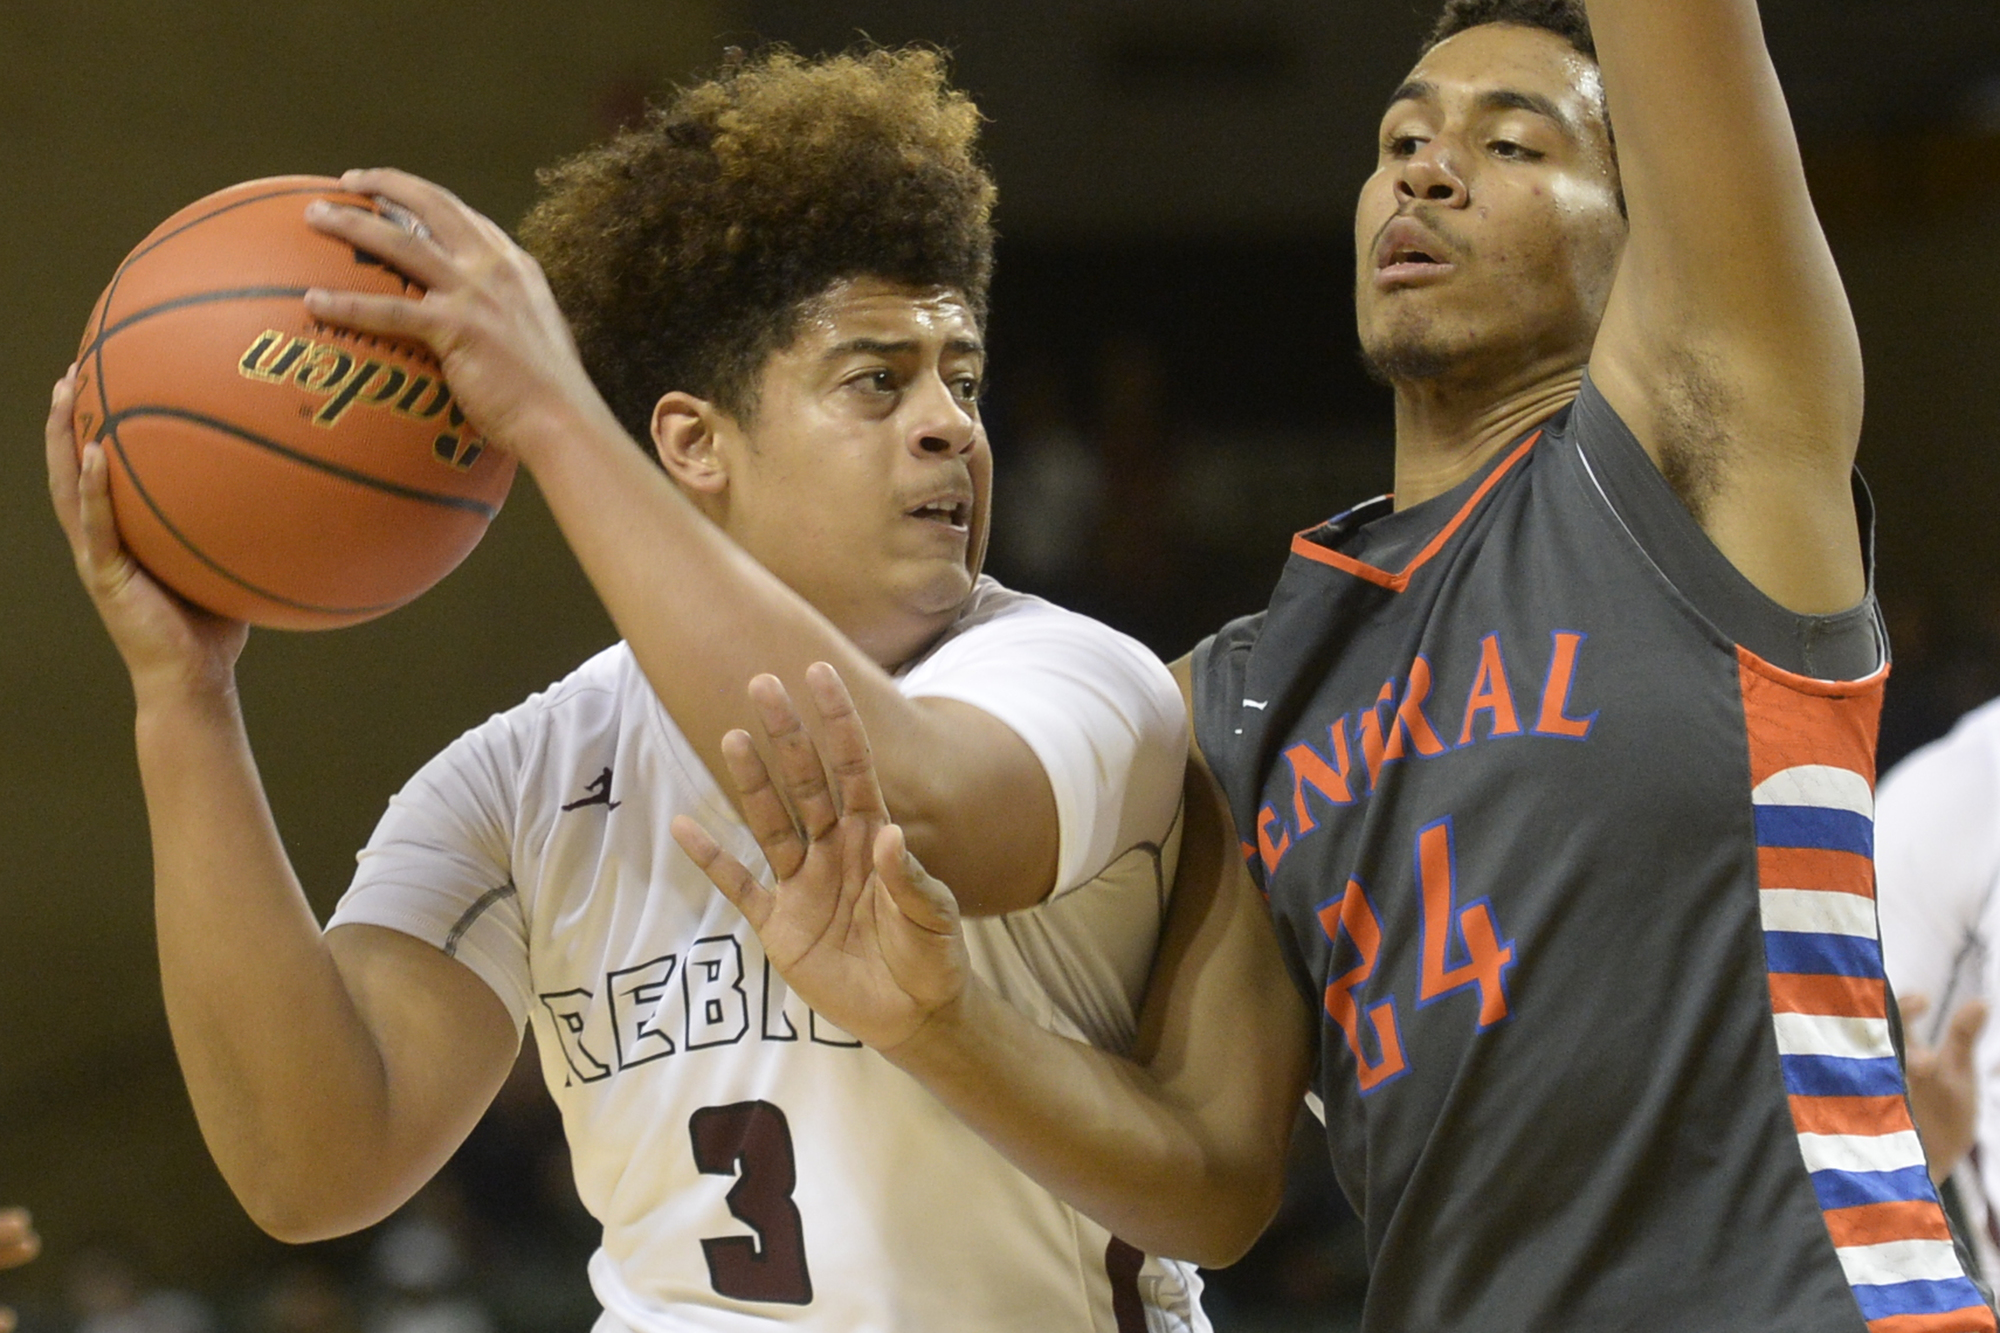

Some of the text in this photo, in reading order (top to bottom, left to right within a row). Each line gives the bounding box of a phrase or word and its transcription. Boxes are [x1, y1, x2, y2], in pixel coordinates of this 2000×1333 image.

[1241, 630, 1599, 898] ENTRAL
[1314, 814, 1517, 1096] 24
[689, 1099, 814, 1306] 3
